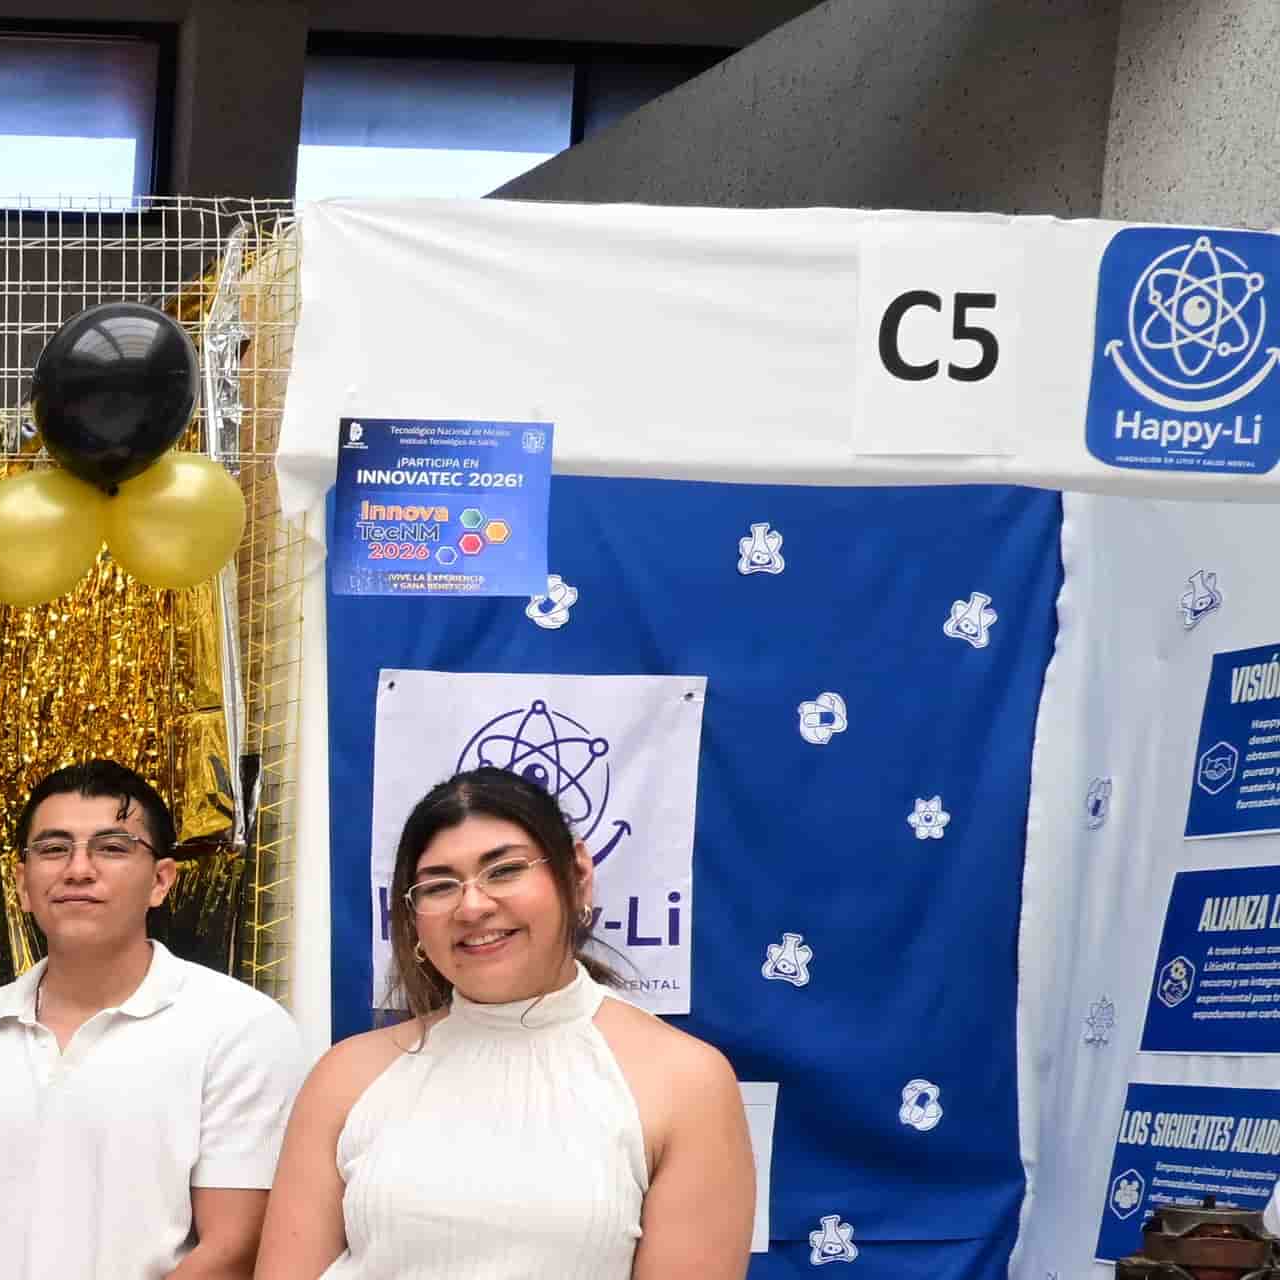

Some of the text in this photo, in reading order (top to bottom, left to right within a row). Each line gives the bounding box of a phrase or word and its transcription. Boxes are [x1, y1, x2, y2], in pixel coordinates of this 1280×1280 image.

[878, 290, 1000, 382] C5
[1114, 409, 1263, 450] Happy-Li
[397, 457, 480, 469] ¡PARTICIPA EN
[356, 469, 524, 488] INNOVATEC 2026!
[359, 500, 449, 523] Innova
[356, 521, 441, 543] TecNM
[367, 543, 430, 560] 2026
[1230, 653, 1280, 705] VISIÓ
[1197, 894, 1271, 932] ALIANZA
[1119, 1110, 1153, 1145] LOS
[1150, 1112, 1235, 1153] SIGUIENTES
